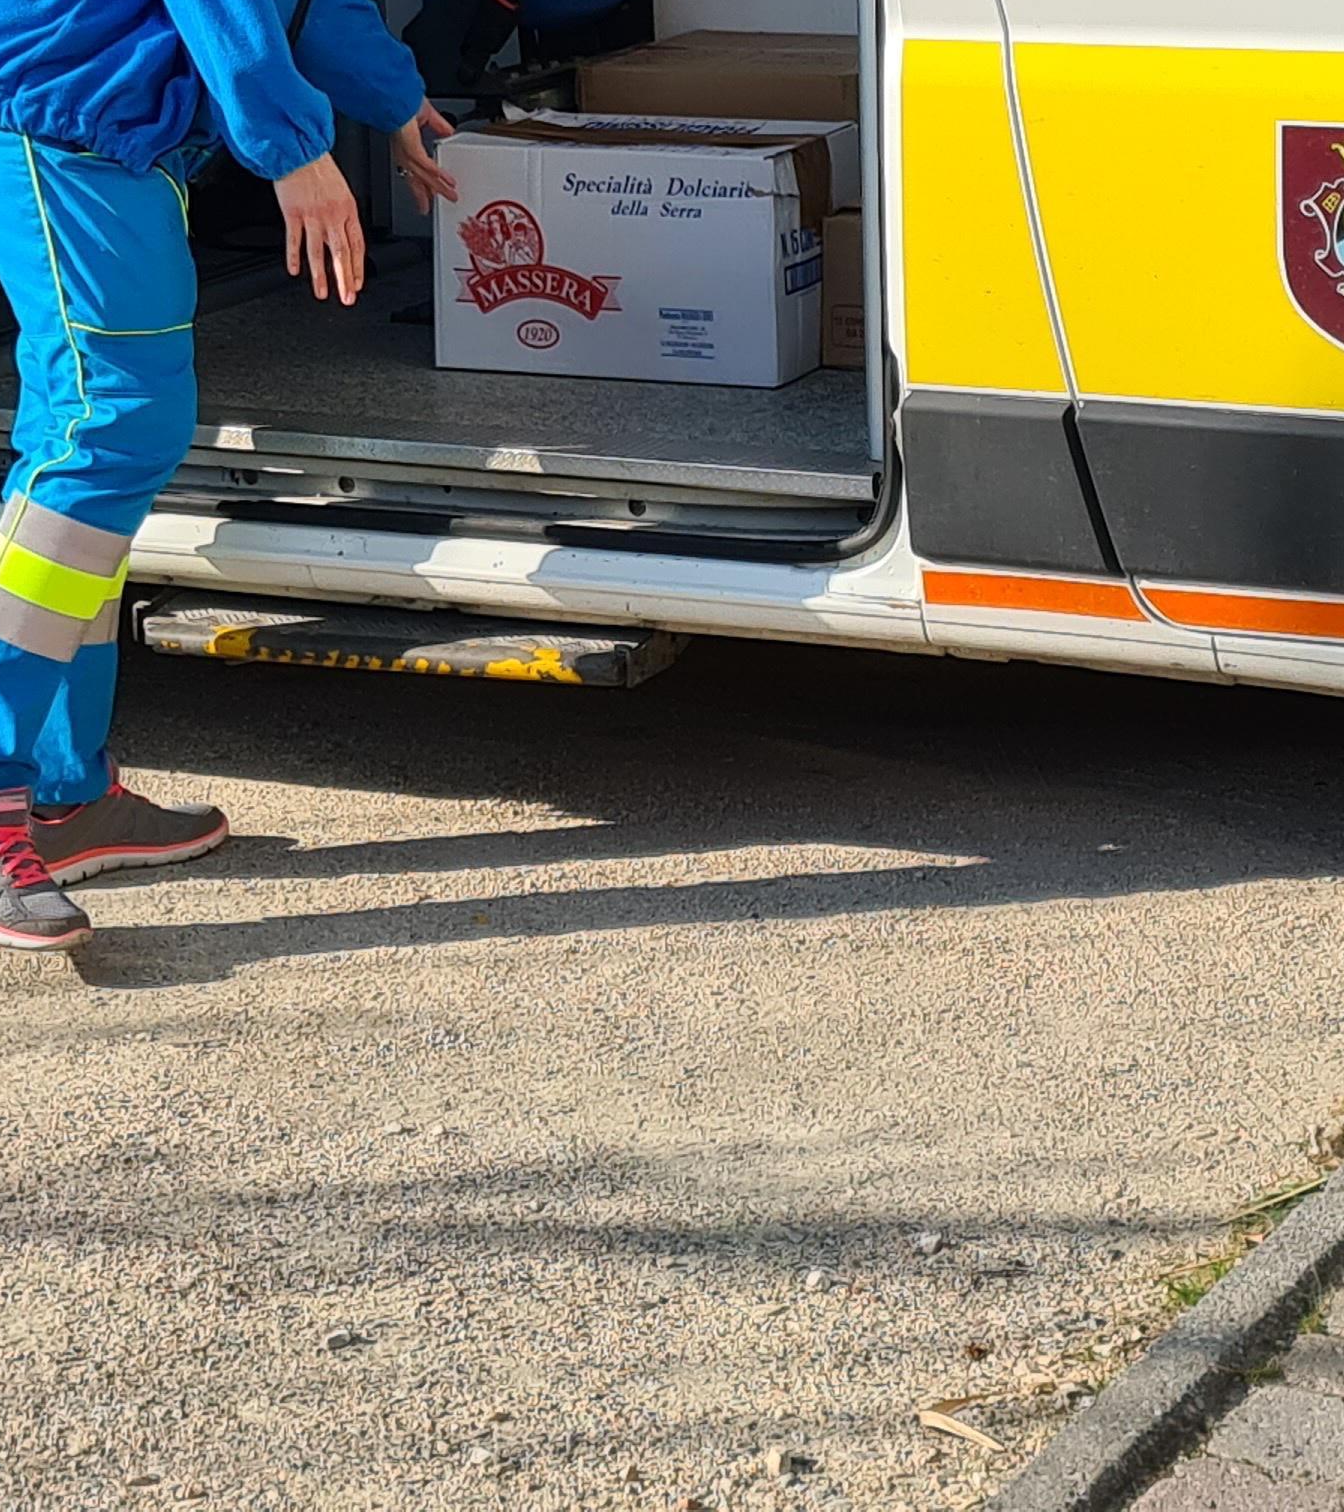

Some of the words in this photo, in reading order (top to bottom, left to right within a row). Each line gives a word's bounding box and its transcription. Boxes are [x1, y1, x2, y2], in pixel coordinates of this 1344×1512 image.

[562, 172, 653, 196] Specialità
[610, 200, 649, 218] della
[659, 201, 703, 219] Serra
[476, 270, 594, 313] MASSERA
[523, 326, 553, 343] 1920
